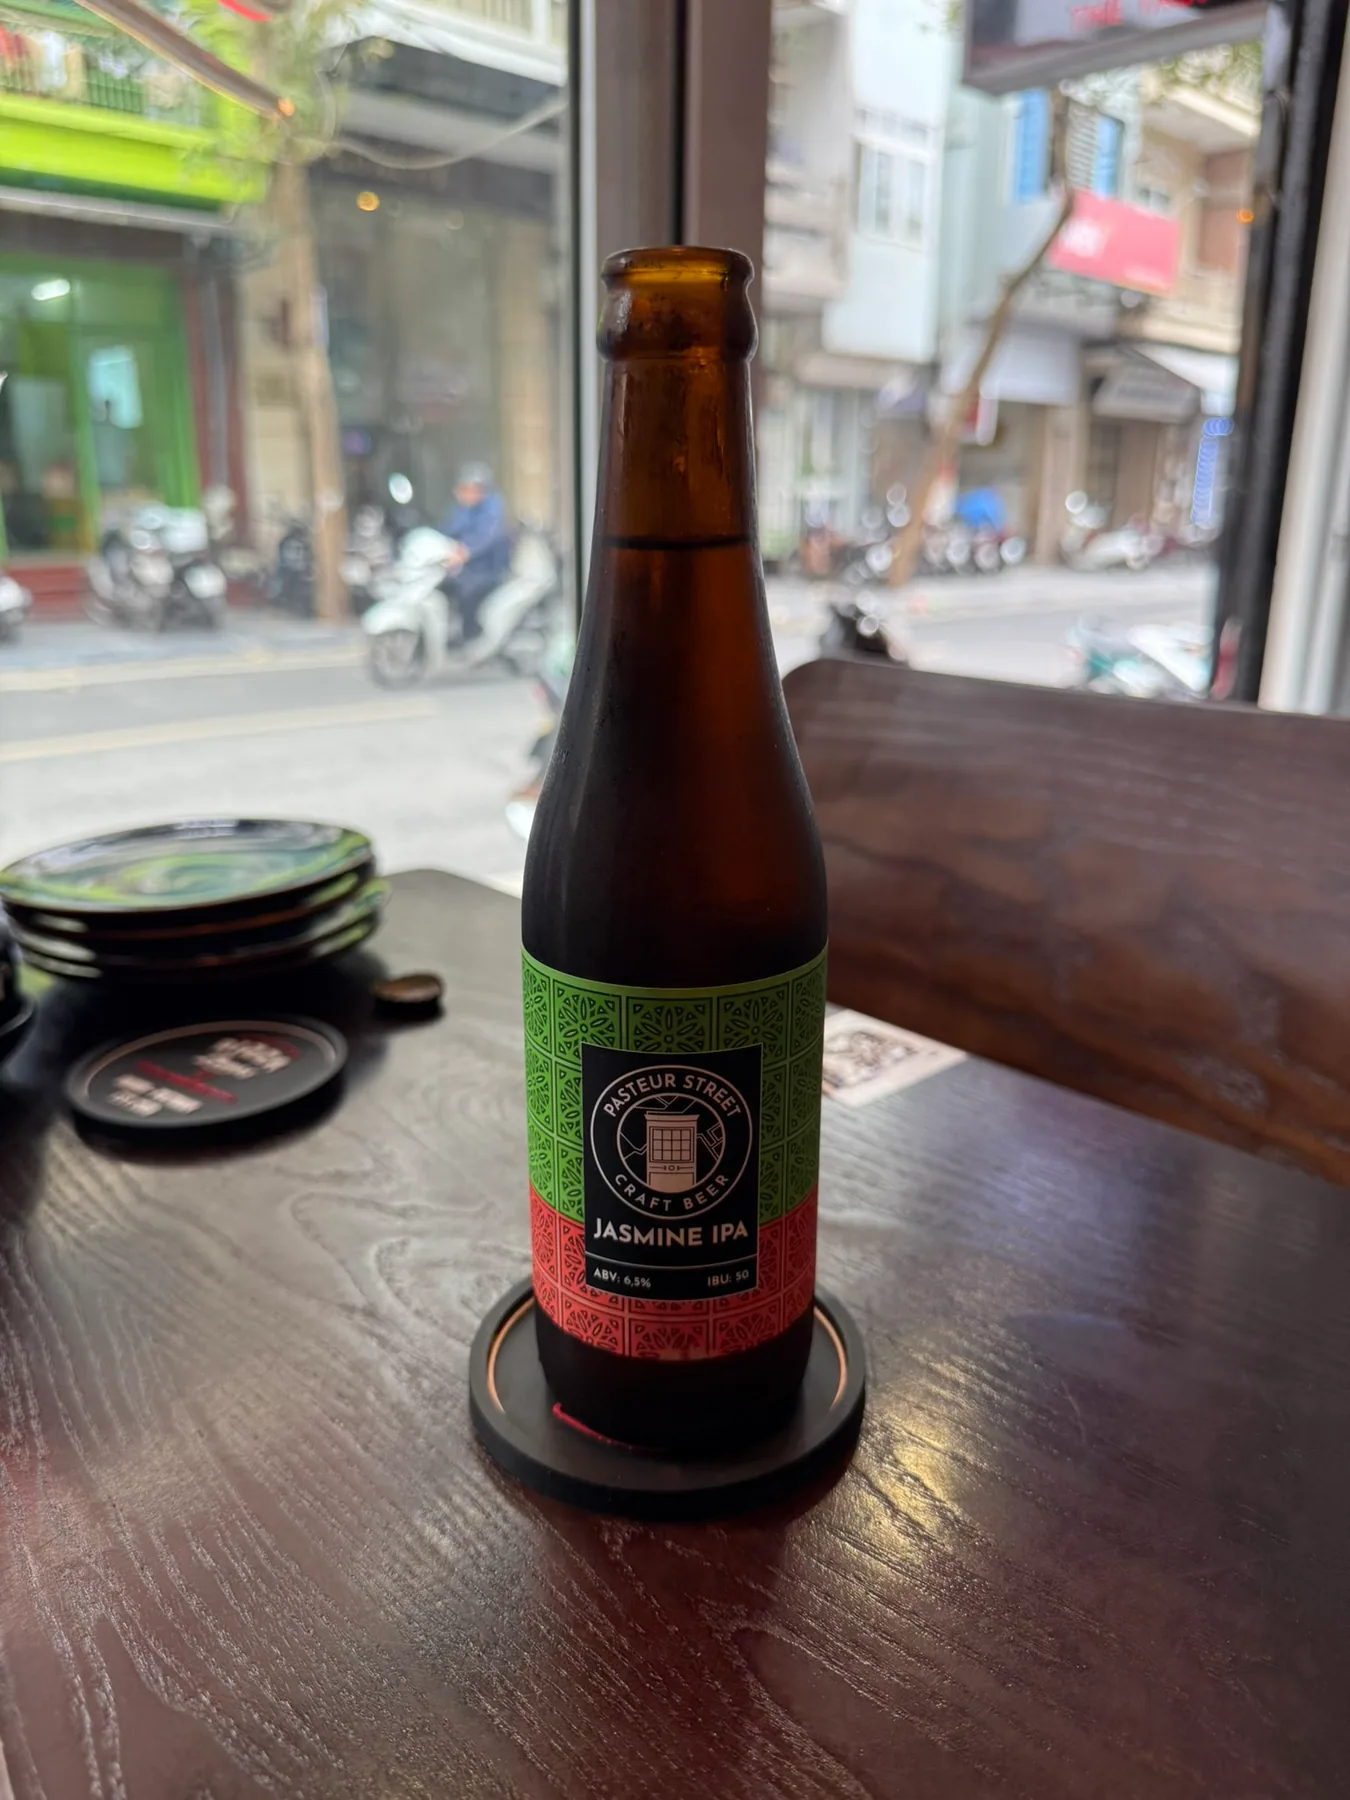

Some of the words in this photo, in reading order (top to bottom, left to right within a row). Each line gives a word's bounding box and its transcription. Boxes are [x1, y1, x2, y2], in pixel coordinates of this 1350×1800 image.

[603, 1073, 676, 1117] PASTEUR
[683, 1074, 741, 1118] STREET
[615, 1173, 672, 1212] CRAFT
[684, 1174, 729, 1210] BEER
[593, 1218, 703, 1247] JASMINE
[713, 1222, 748, 1244] IPA
[593, 1268, 621, 1282] ABV:
[708, 1274, 732, 1287] IBU:
[736, 1270, 749, 1281] 50
